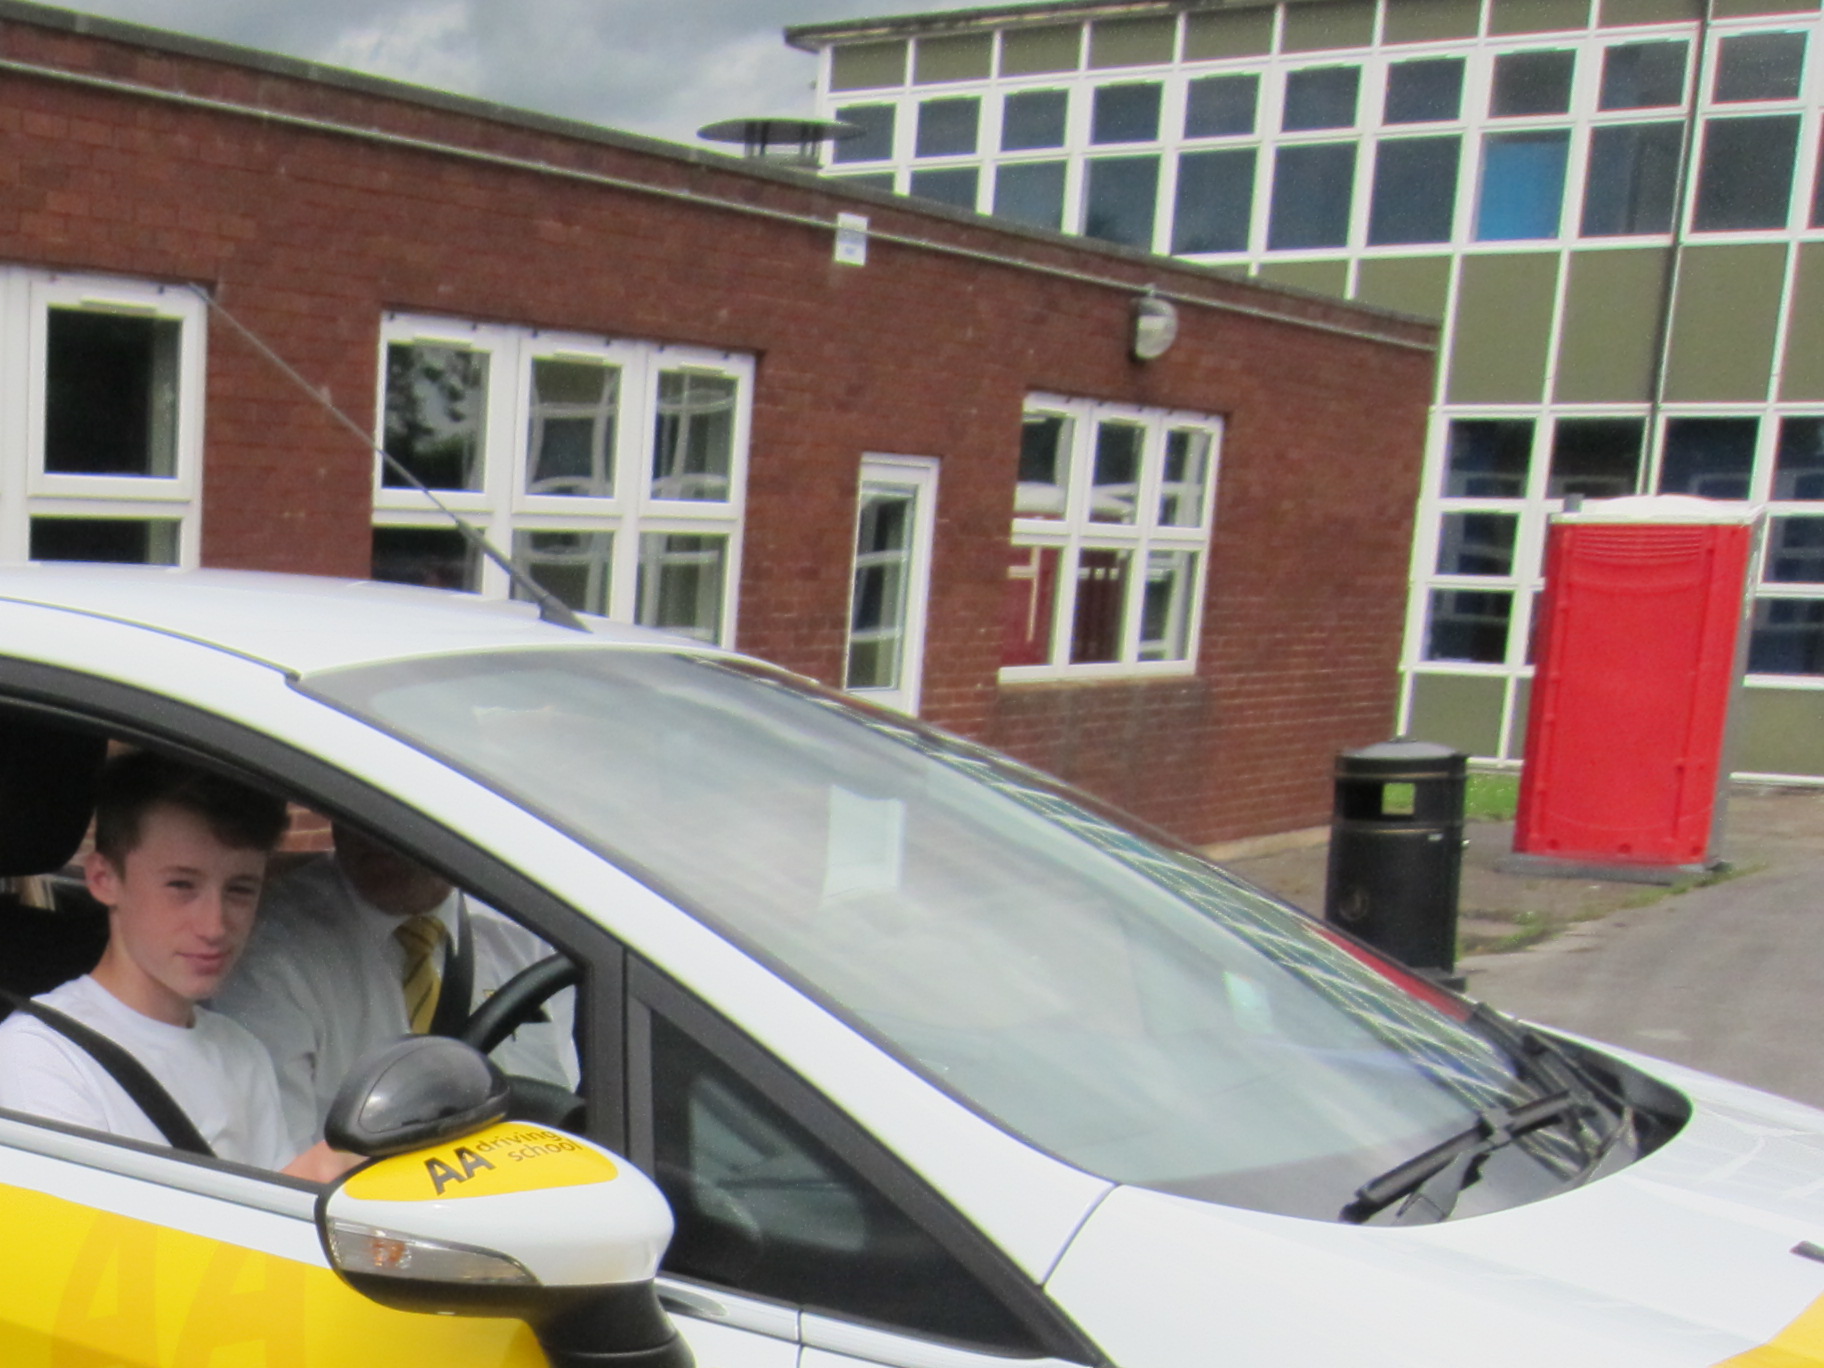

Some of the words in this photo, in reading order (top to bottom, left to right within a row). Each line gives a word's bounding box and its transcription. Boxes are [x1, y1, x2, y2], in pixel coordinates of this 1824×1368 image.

[476, 1130, 561, 1153] driving
[507, 1139, 584, 1162] school
[423, 1146, 496, 1196] AA
